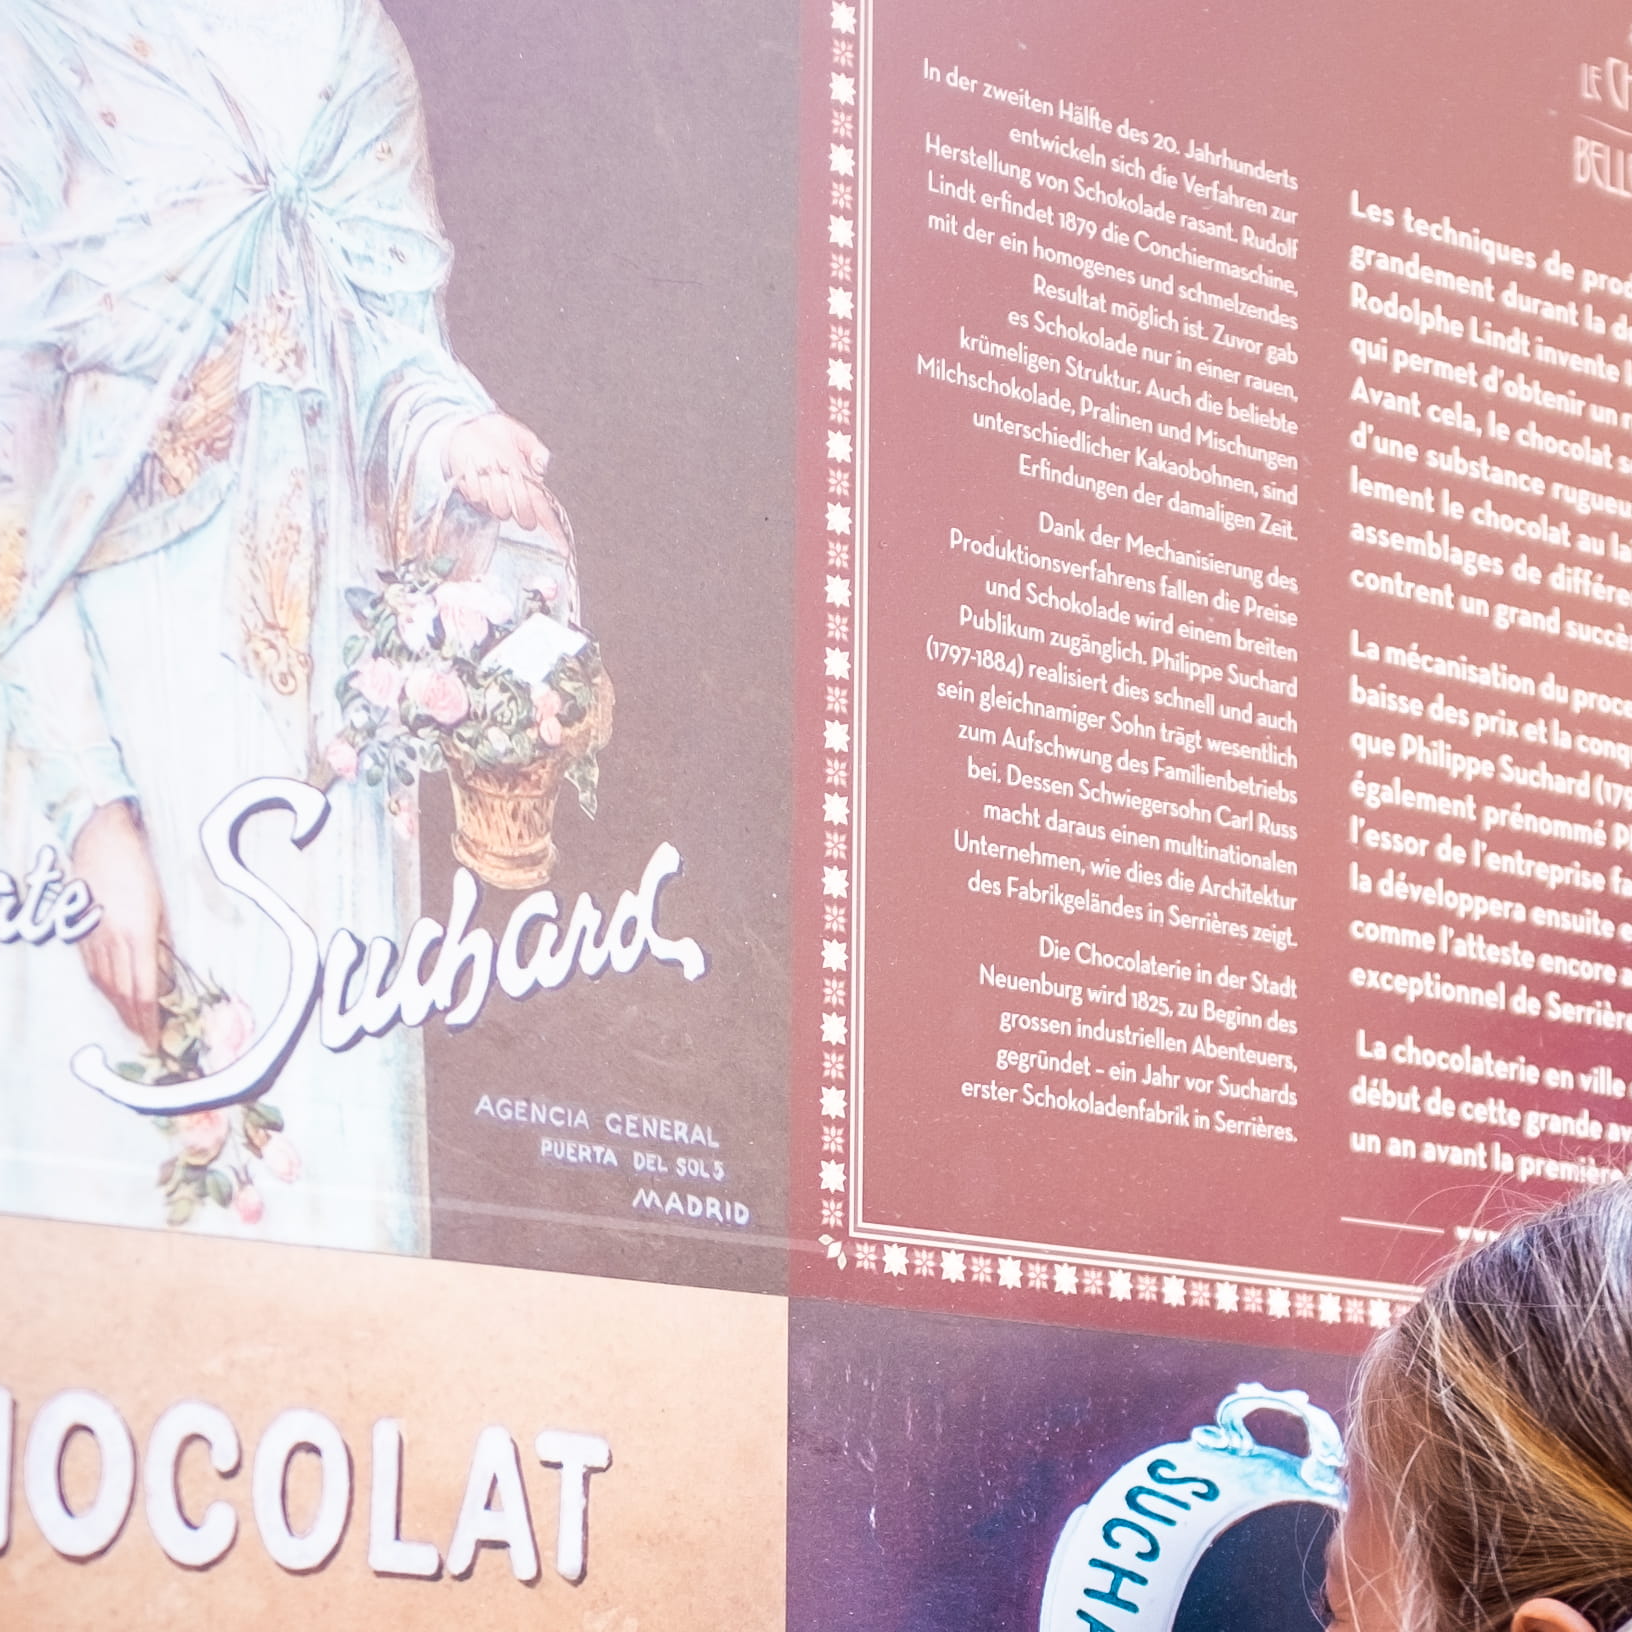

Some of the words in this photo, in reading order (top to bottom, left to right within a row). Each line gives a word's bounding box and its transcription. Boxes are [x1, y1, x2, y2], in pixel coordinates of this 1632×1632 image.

[1580, 62, 1602, 101] LE
[924, 58, 940, 82] In
[946, 66, 978, 93] der
[983, 82, 1053, 117] zweiten
[1059, 99, 1112, 134] Hälfte
[1116, 117, 1149, 145] des
[1153, 133, 1180, 155] 20.
[1184, 138, 1298, 191] Jahrhunderts
[926, 132, 1032, 189] Herstellung
[1036, 172, 1068, 194] von
[1074, 176, 1176, 225] Schokolade
[1180, 214, 1238, 243] rasant.
[1242, 225, 1298, 260] Rudolf
[1009, 128, 1106, 169] entwickeln
[1111, 154, 1145, 180] sich
[1150, 163, 1177, 190] die
[1182, 172, 1267, 217] Verfahren
[1271, 205, 1298, 225] zur
[929, 170, 976, 204] Lindt
[981, 189, 1054, 226] erfindet
[1059, 211, 1097, 240] 1879
[1101, 221, 1129, 247] die
[1134, 230, 1298, 298] Conchiermaschine,
[929, 213, 957, 236] mit
[963, 218, 995, 245] der
[1000, 231, 1027, 255] ein
[1033, 236, 1135, 285] homogenes
[1140, 274, 1173, 296] und
[1178, 282, 1298, 330] schmelzendes
[1351, 189, 1394, 227] Les
[1403, 207, 1536, 270] techniques
[1543, 249, 1574, 281] de
[1008, 311, 1029, 329] es
[1034, 310, 1137, 357] Schokolade
[1142, 347, 1172, 366] nur
[1176, 350, 1192, 372] in
[1196, 358, 1241, 384] einer
[1245, 374, 1298, 403] rauen,
[1034, 273, 1107, 313] Resultat
[1111, 302, 1178, 333] möglich
[1183, 316, 1208, 341] ist.
[1212, 323, 1263, 355] Zuvor
[1266, 342, 1298, 366] gab
[918, 353, 1075, 417] Milchschokolade,
[1081, 395, 1152, 434] Pralinen
[1157, 422, 1191, 443] und
[1196, 425, 1297, 471] Mischungen
[960, 326, 1060, 374] krümeligen
[1066, 355, 1141, 395] Struktur.
[1146, 378, 1191, 407] Auch
[1195, 390, 1223, 416] die
[1227, 397, 1298, 435] beliebte
[973, 412, 1130, 463] unterschiedlicher
[1136, 446, 1258, 498] Kakaobohnen,
[1263, 481, 1297, 506] sind
[1019, 453, 1128, 501] Erfindungen
[1132, 481, 1163, 508] der
[1167, 490, 1255, 532] damaligen
[1259, 512, 1297, 541] Zeit.
[1350, 569, 1454, 610] contrent
[1460, 595, 1489, 618] un
[1493, 603, 1560, 635] grand
[1351, 629, 1379, 661] La
[1385, 642, 1535, 696] mécanisation
[1538, 672, 1568, 705] du
[1350, 731, 1395, 760] que
[1400, 733, 1495, 782] Philippe
[1499, 754, 1590, 799] Suchard
[70, 775, 707, 1117] Suchard
[1040, 935, 1070, 961] Die
[1075, 941, 1191, 981] Chocolaterie
[1196, 962, 1212, 985] in
[1216, 965, 1247, 990] der
[1250, 970, 1297, 999] Stadt
[980, 963, 1083, 1007] Neuenburg
[1087, 984, 1126, 1008] wird
[1131, 990, 1173, 1017] 1825,
[1178, 1002, 1197, 1019] zu
[1202, 999, 1262, 1031] Beginn
[1266, 1009, 1297, 1035] des
[1350, 967, 1505, 1010] exceptionnel
[1510, 985, 1541, 1017] de
[996, 1049, 1090, 1077] gegründet
[1109, 1060, 1136, 1082] ein
[1142, 1063, 1180, 1089] Jahr
[1185, 1076, 1214, 1094] vor
[1218, 1074, 1297, 1107] Suchards
[1000, 1012, 1071, 1036] grossen
[1077, 1017, 1187, 1054] industriellen
[1191, 1034, 1297, 1073] Abenteuers,
[1359, 1029, 1386, 1060] La
[1392, 1036, 1540, 1085] chocolaterie
[1543, 1067, 1574, 1090] en
[1579, 1066, 1626, 1099] ville
[474, 1094, 590, 1130] AGENCIA
[605, 1112, 720, 1148] GENERAL
[962, 1079, 1018, 1103] erster
[1023, 1083, 1189, 1127] Schokoladenfabrik
[1194, 1108, 1210, 1130] in
[1215, 1110, 1297, 1143] Serrières.
[540, 1137, 618, 1167] PUERTA
[633, 1151, 668, 1173] DEL
[632, 1187, 750, 1226] MADRID
